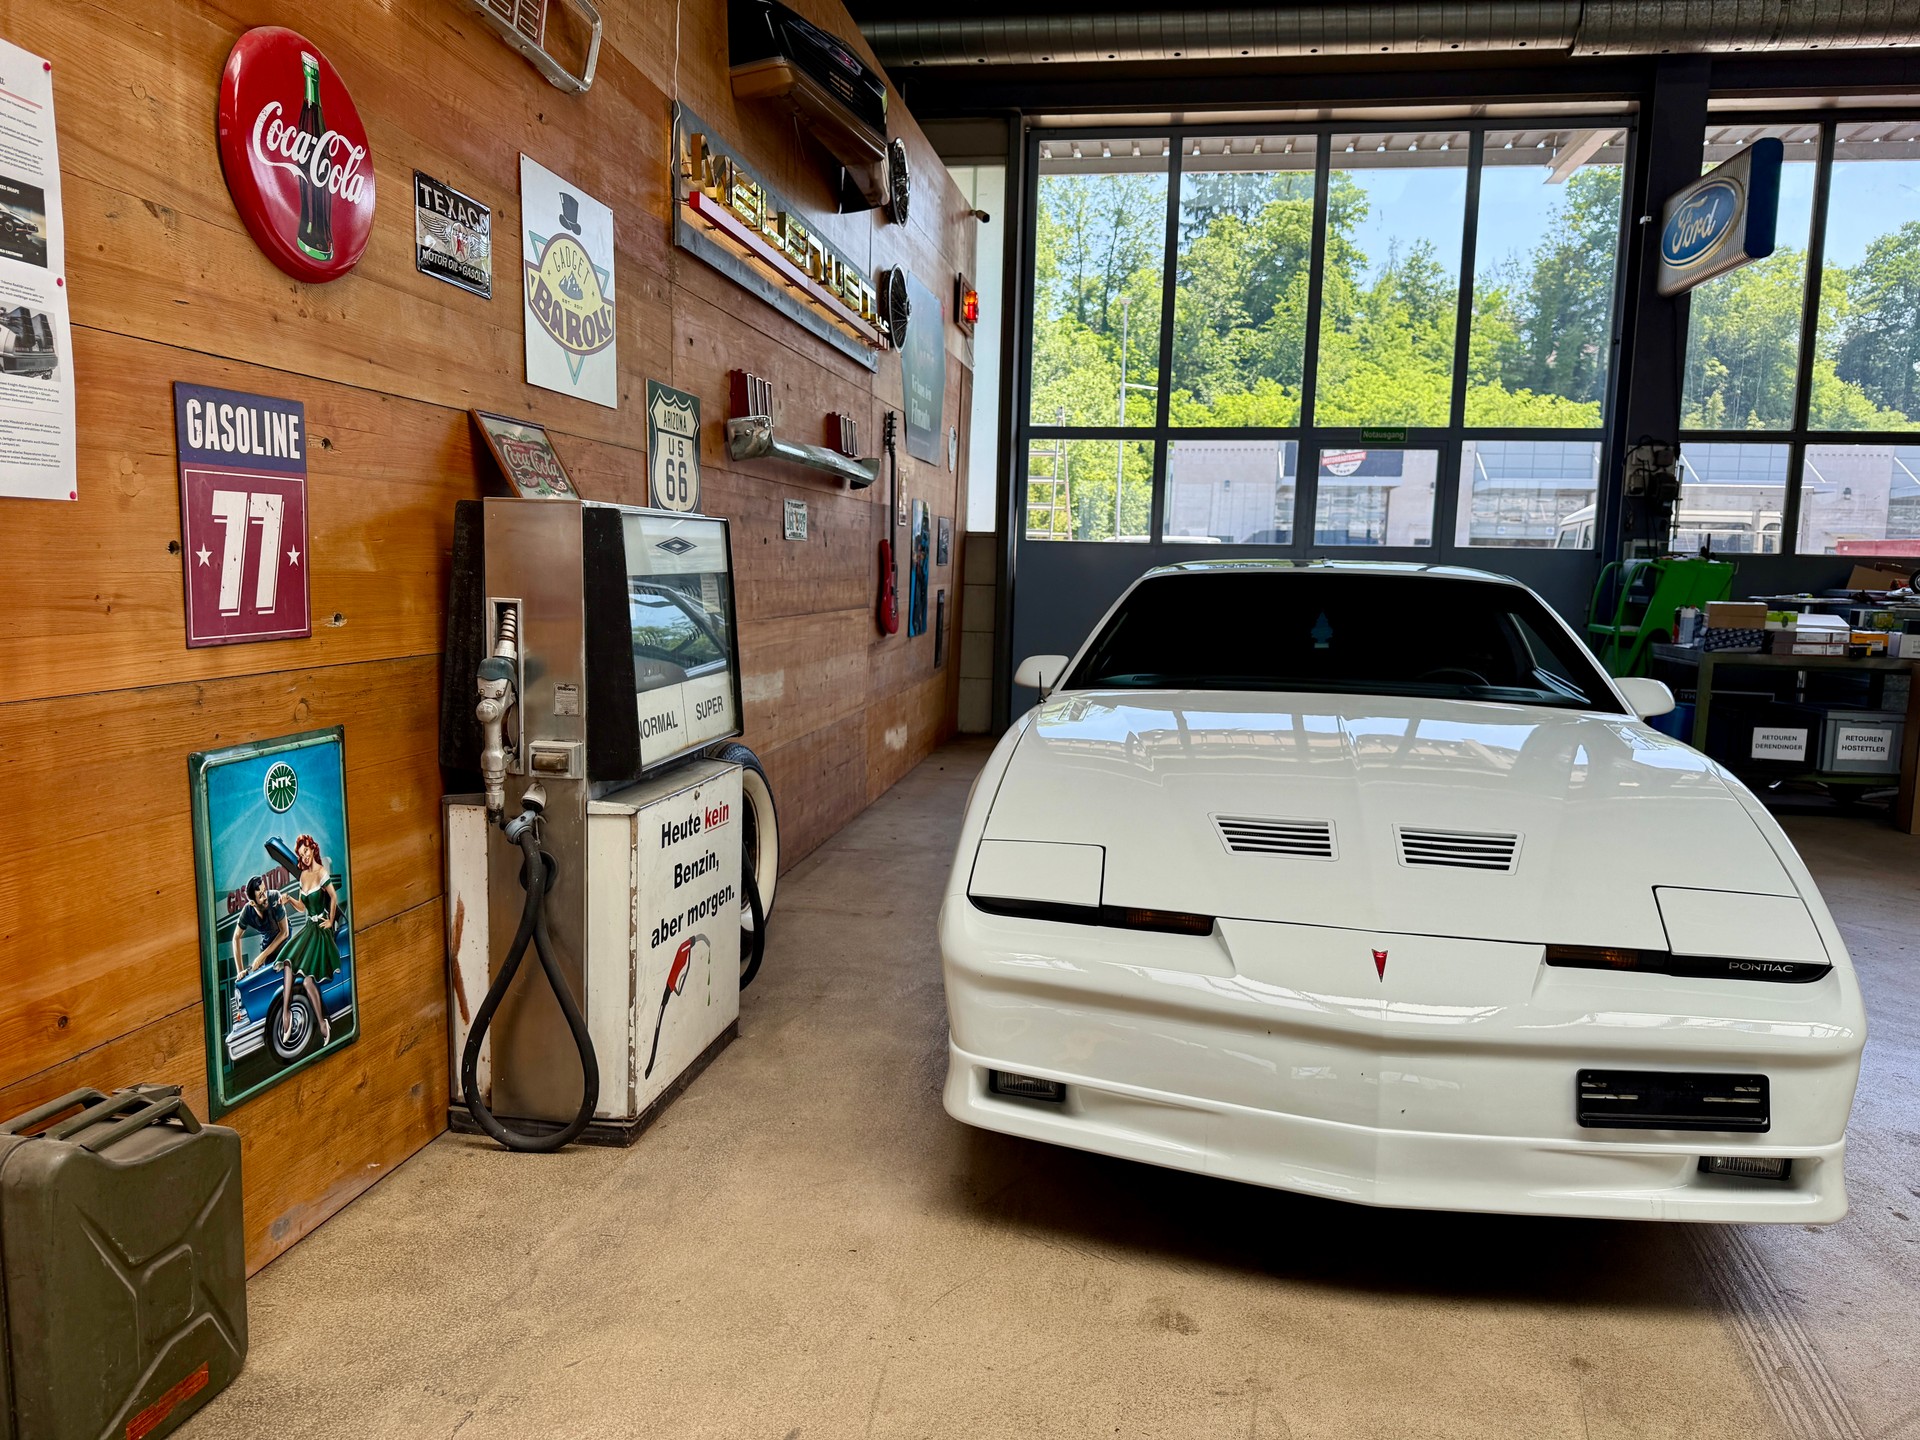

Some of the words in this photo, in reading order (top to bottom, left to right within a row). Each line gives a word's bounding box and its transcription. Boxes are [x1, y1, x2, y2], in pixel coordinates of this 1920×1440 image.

[252, 101, 366, 204] Coca-Cola
[420, 182, 489, 234] TEXACO
[1672, 195, 1720, 254] Ford
[422, 248, 448, 268] MOTOR
[448, 259, 459, 272] OIL
[553, 246, 590, 285] GADGET
[532, 274, 611, 348] BARON
[186, 399, 301, 460] GASOLINE
[663, 409, 688, 433] ARIZONA
[1363, 430, 1405, 440] Notausgang
[668, 439, 684, 458] US
[665, 457, 688, 503] 66
[695, 695, 724, 721] SUPER
[1755, 743, 1803, 751] DERENDINGER
[1762, 734, 1798, 742] RETOUREN
[1841, 744, 1886, 753] HOSTETTLER
[1845, 734, 1884, 743] RETOUREN
[271, 775, 292, 790] NTK
[660, 812, 701, 849] Heute
[704, 800, 730, 830] kein
[674, 849, 720, 890] Benzin,
[651, 911, 684, 949] aber
[687, 883, 736, 926] morgen.
[1728, 961, 1794, 974] PONTIAC
